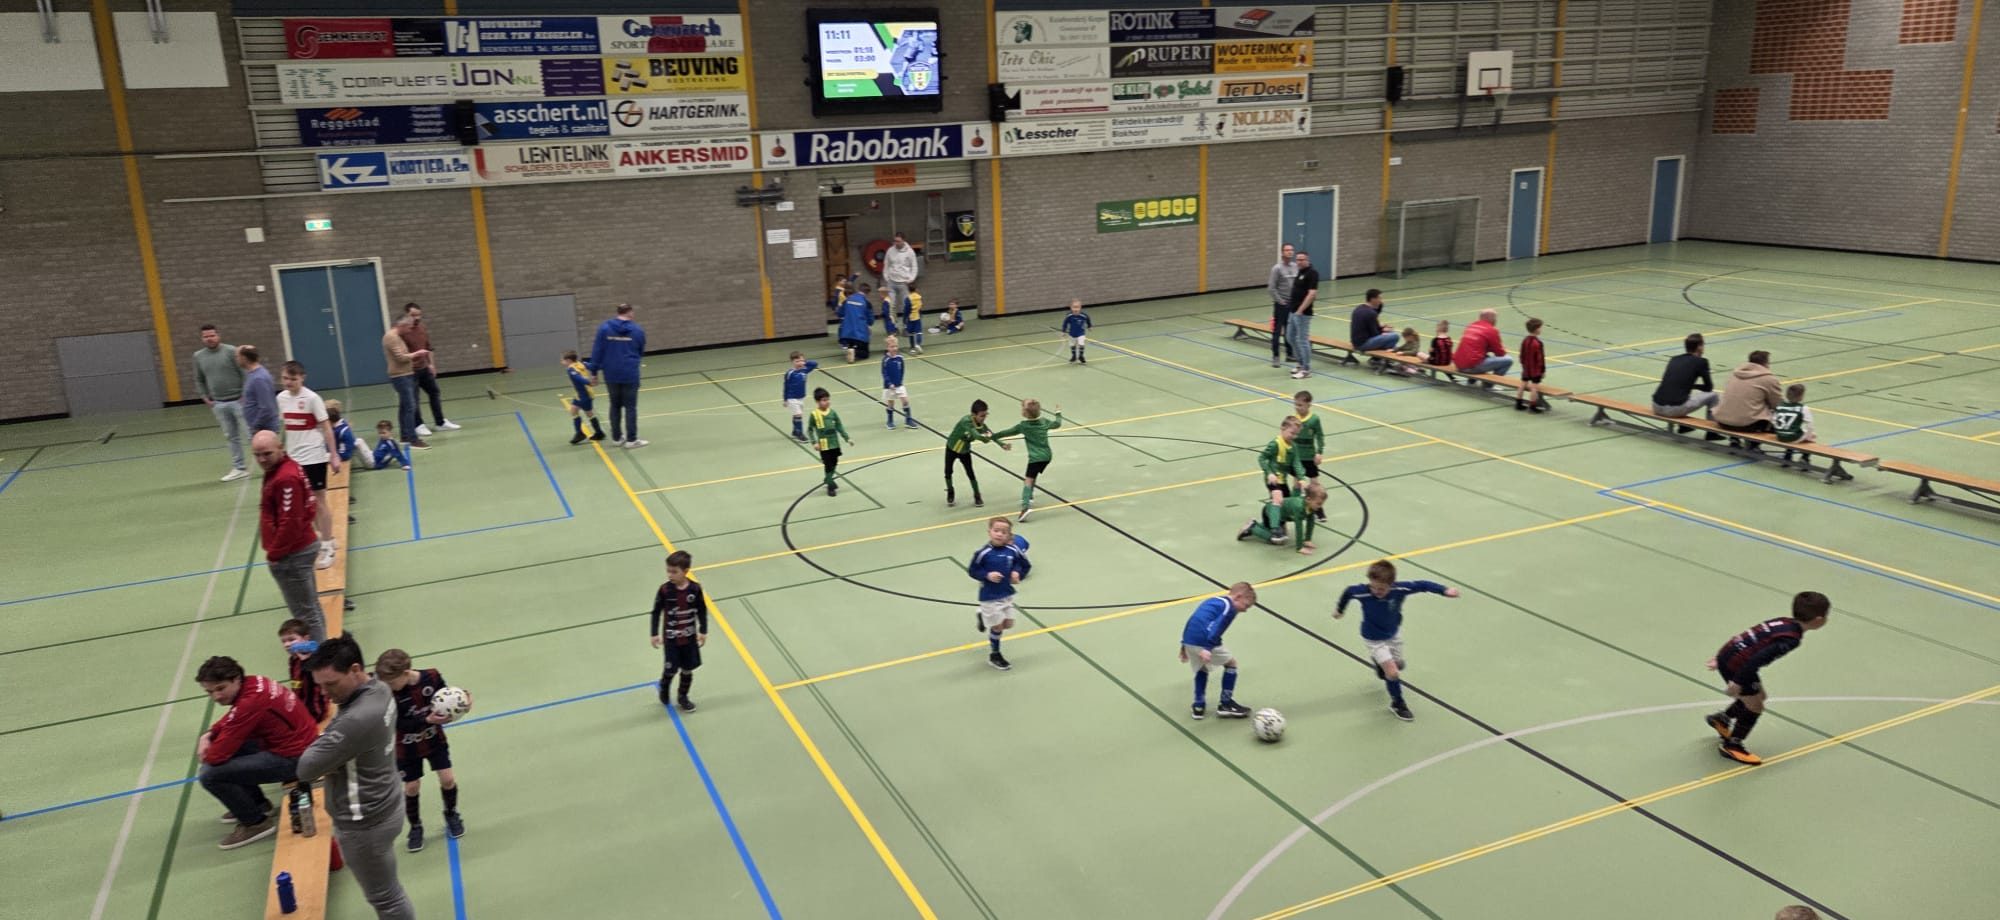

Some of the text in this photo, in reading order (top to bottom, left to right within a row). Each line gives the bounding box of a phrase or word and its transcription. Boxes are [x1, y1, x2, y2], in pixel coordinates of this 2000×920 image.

[1111, 12, 1175, 31] ROTINK
[825, 30, 850, 39] 11:11
[1148, 45, 1213, 62] RUPERT
[1217, 43, 1294, 56] WOLTERINCK
[648, 57, 739, 77] BEUVING
[1224, 81, 1302, 97] Ter Doest
[494, 102, 607, 124] asschert.nl
[649, 103, 739, 120] HARTGERINK
[1232, 110, 1293, 126] NOLLEN
[311, 117, 380, 131] Reggestad
[1016, 127, 1078, 140] Lesscher
[519, 144, 608, 164] LENTELINK
[809, 128, 949, 164] Rabobank
[619, 145, 749, 167] ANKERSMID
[1775, 412, 1798, 430] 37
